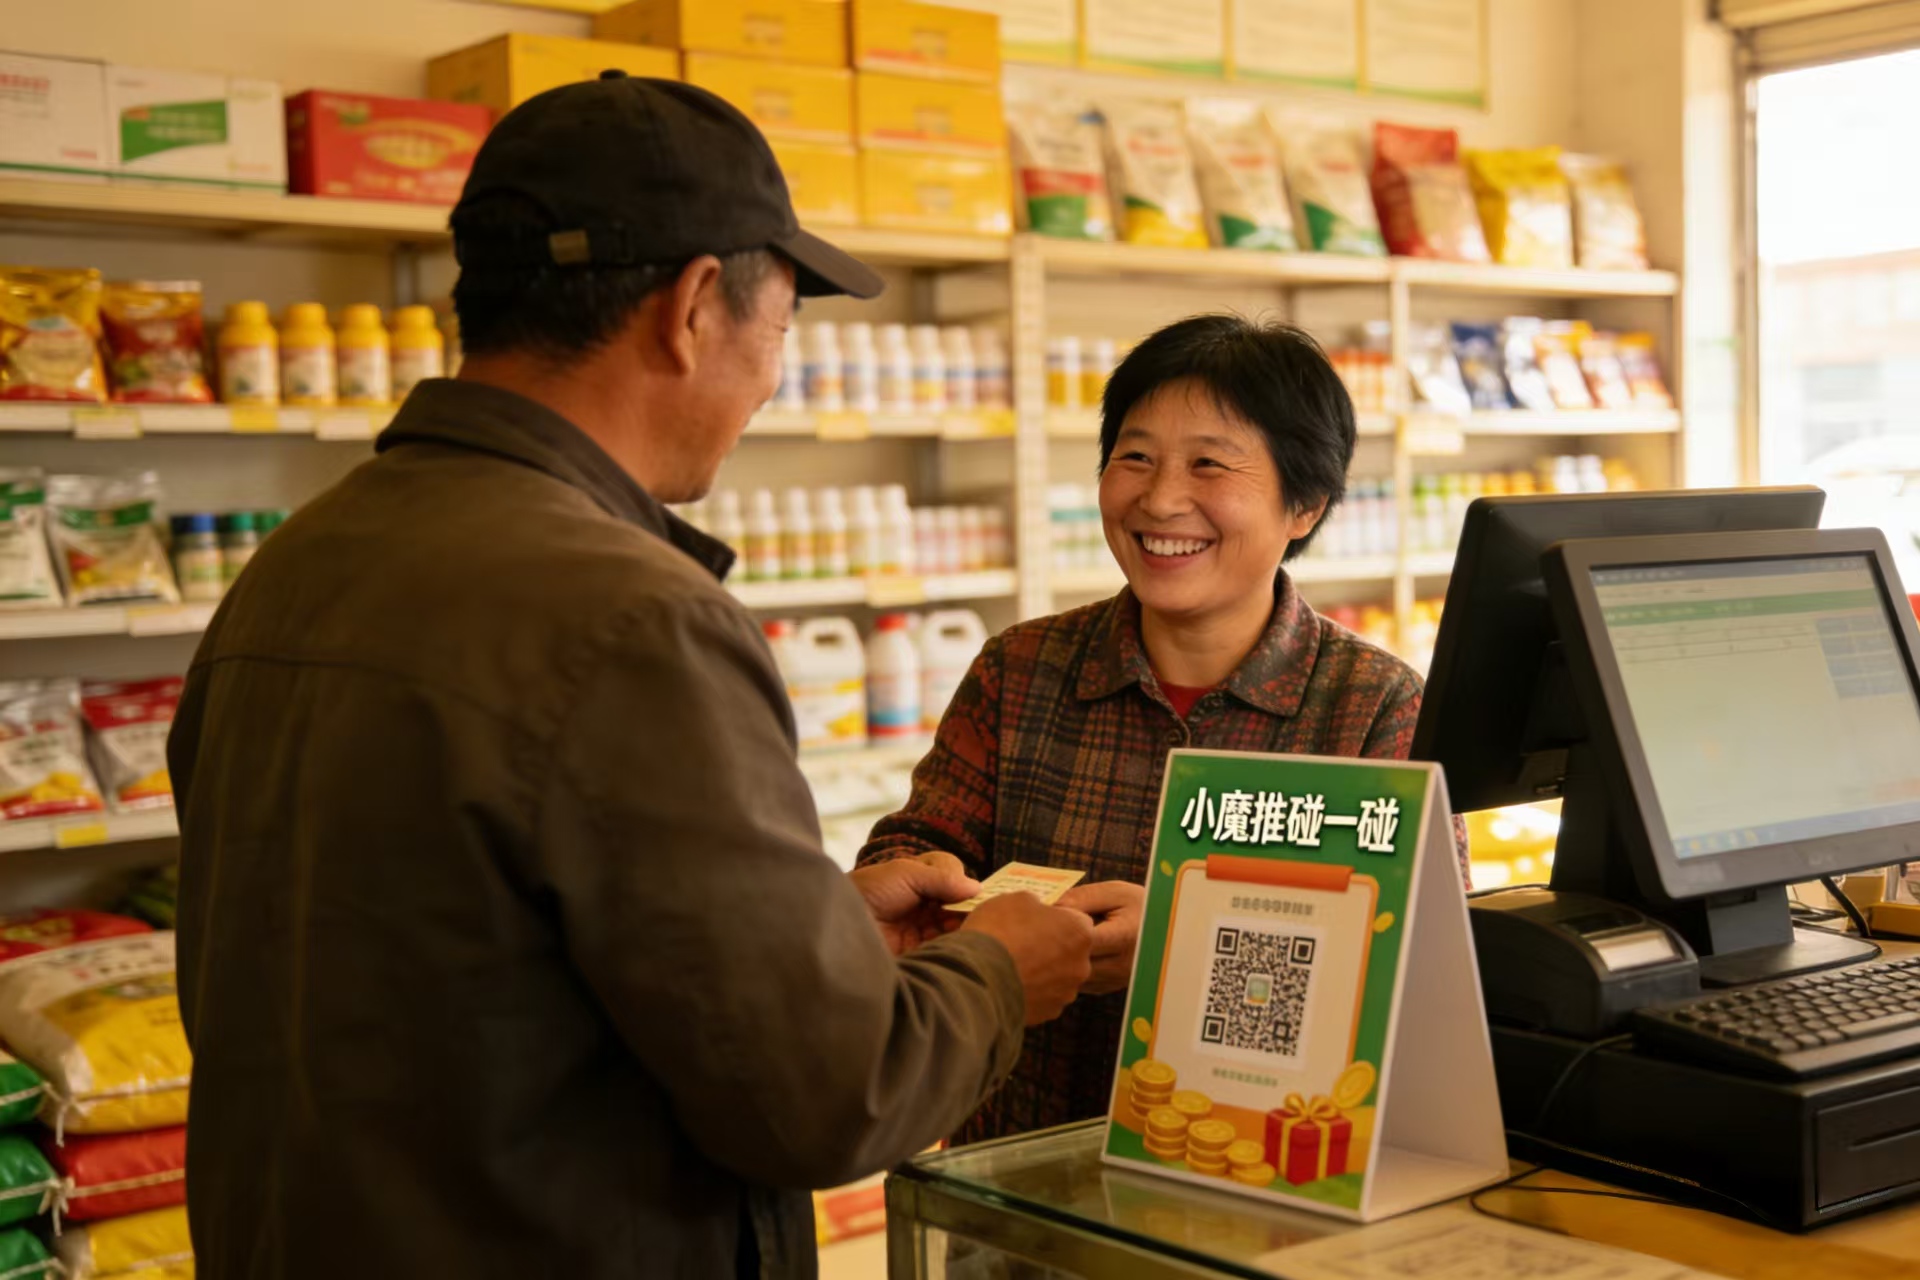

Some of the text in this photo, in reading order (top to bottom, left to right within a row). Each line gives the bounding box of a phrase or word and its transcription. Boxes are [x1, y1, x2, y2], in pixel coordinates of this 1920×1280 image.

[1180, 786, 1400, 853] 小魔推碰一碰
